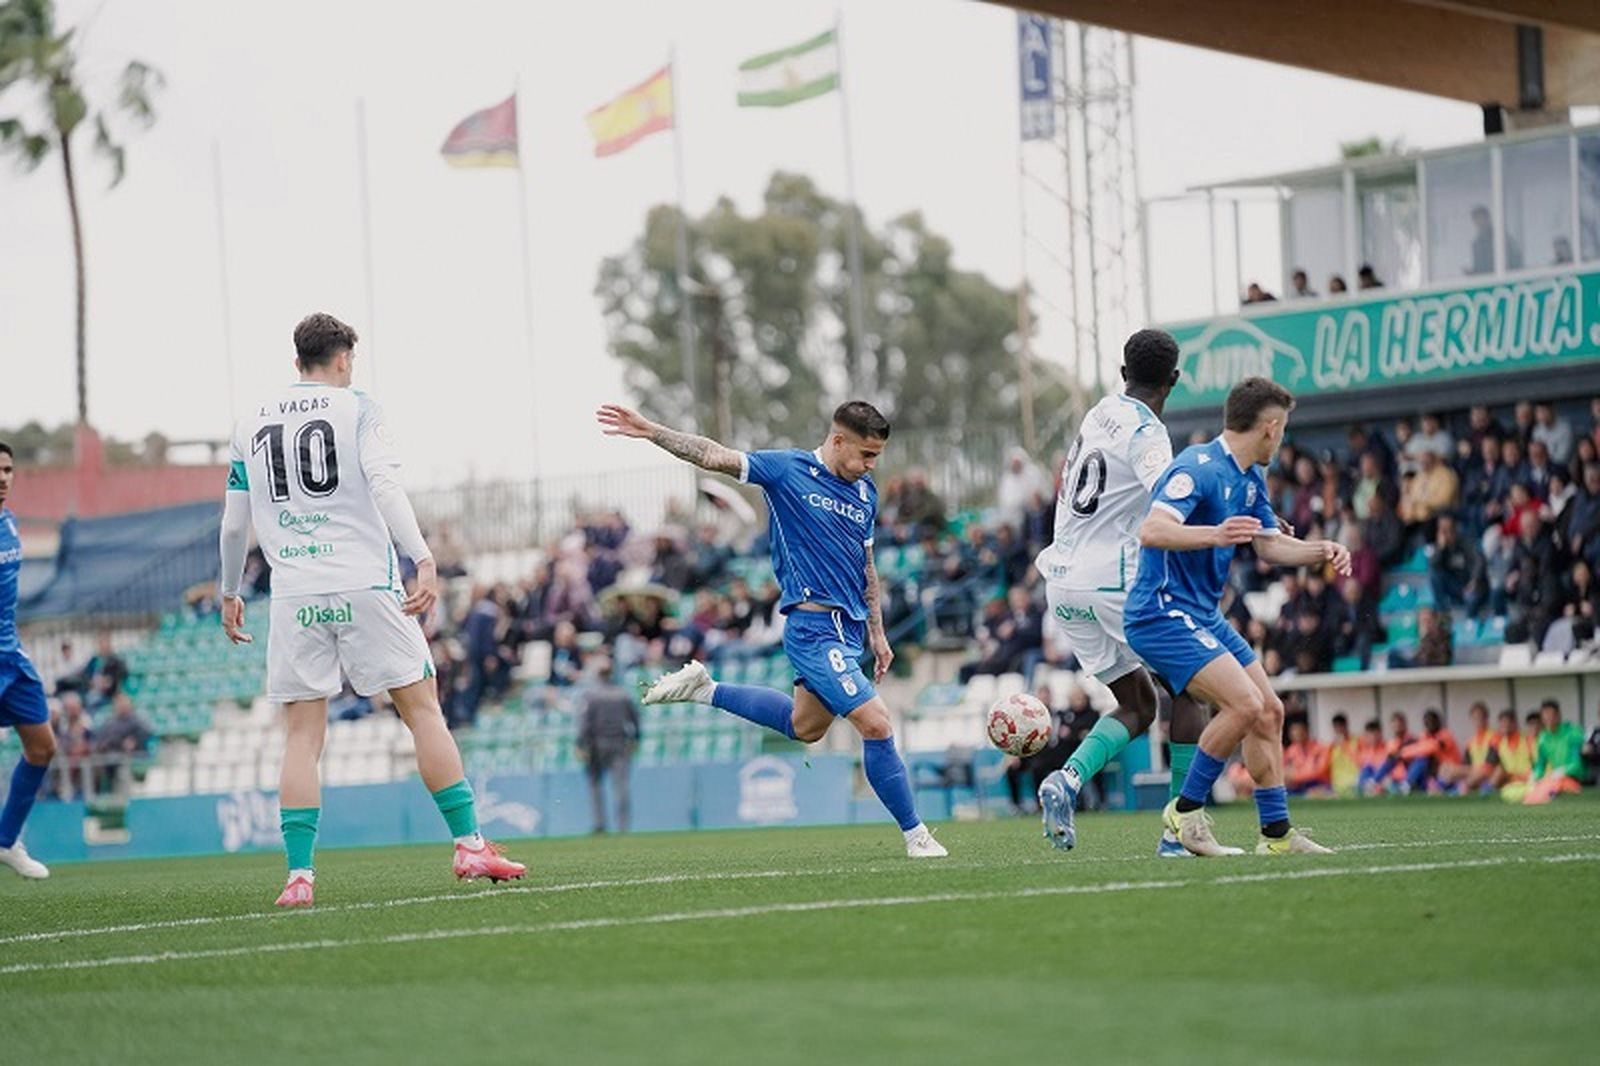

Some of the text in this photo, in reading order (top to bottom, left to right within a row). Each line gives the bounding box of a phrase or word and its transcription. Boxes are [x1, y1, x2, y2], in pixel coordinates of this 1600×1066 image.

[1312, 311, 1370, 388] LA
[1379, 276, 1582, 378] HERMITA
[279, 397, 329, 413] VACAS
[251, 419, 339, 503] 10
[809, 493, 865, 523] ceuta
[828, 647, 847, 673] 8
